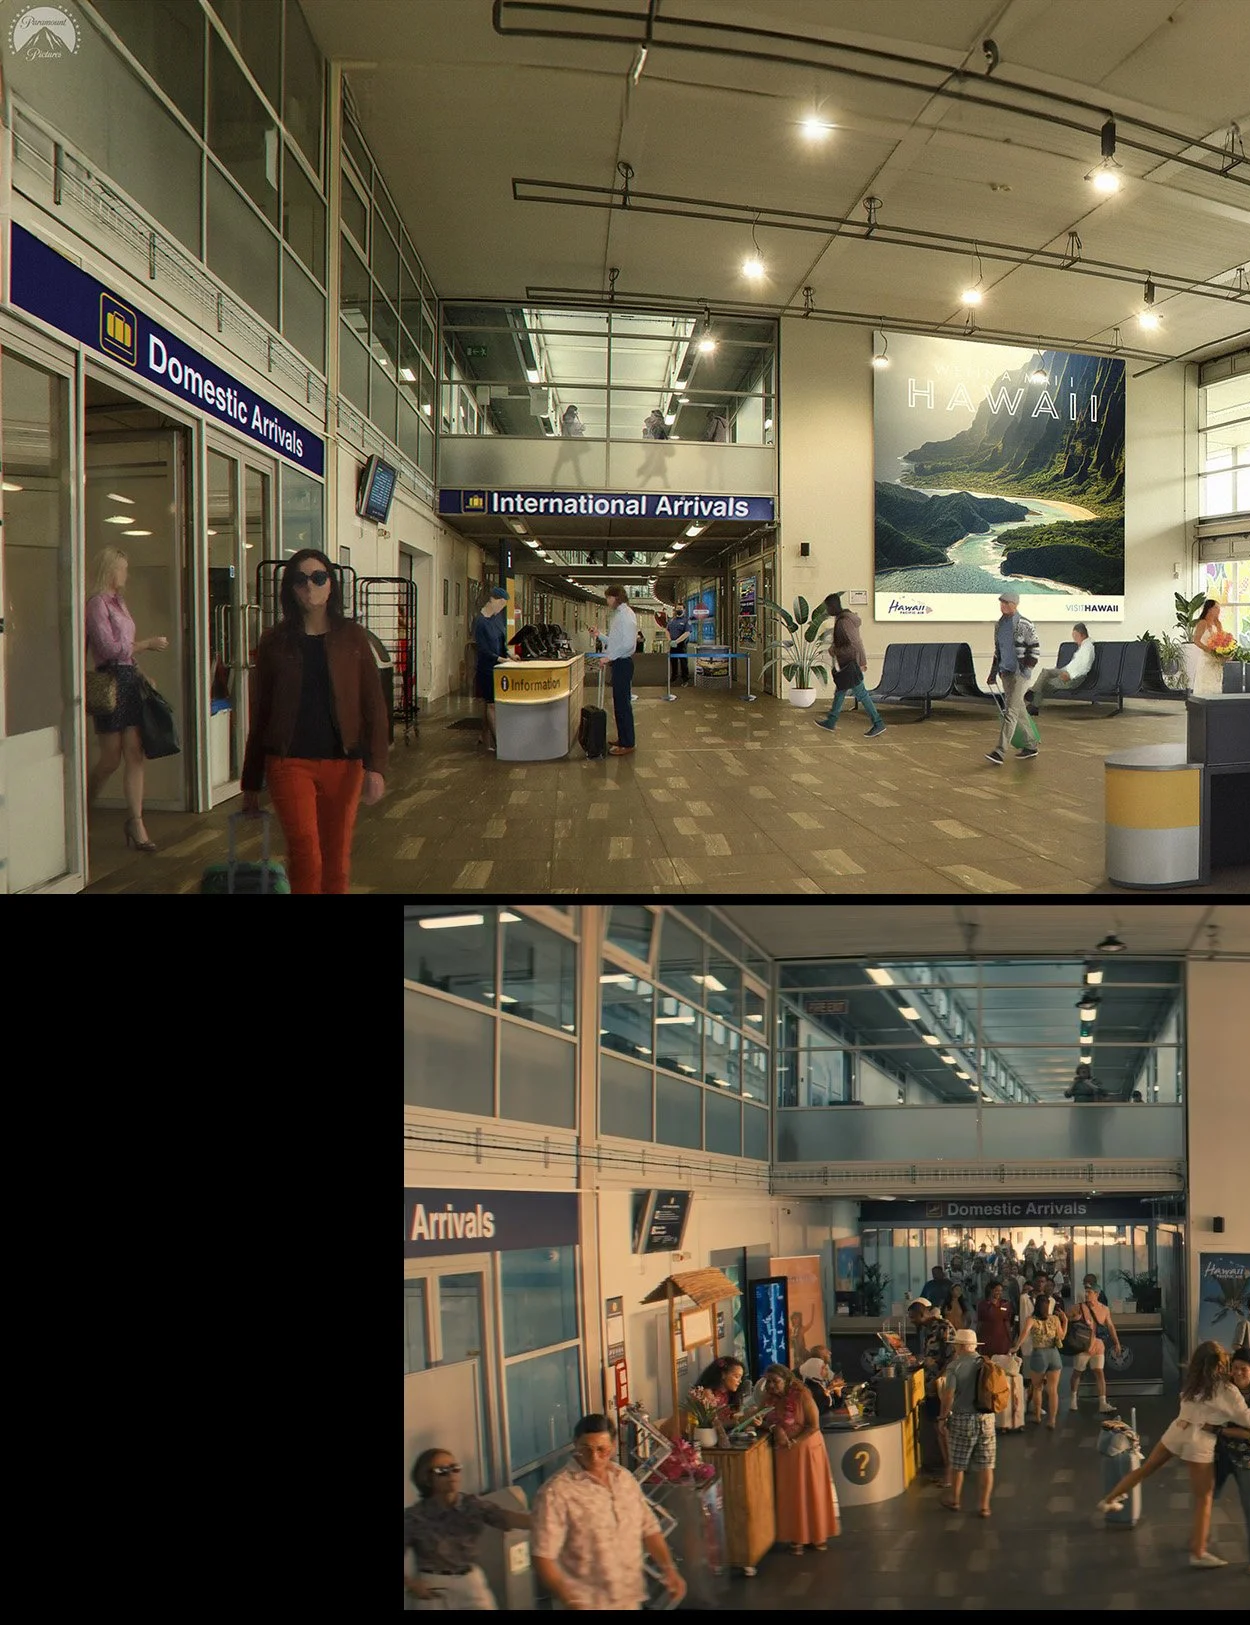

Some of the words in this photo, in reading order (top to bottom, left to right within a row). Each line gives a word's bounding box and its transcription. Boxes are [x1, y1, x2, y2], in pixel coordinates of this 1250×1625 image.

[149, 334, 248, 424] Domestic
[251, 405, 303, 457] Arrivals
[908, 377, 1098, 423] HAWAII
[493, 492, 647, 515] International
[655, 495, 749, 518] Arrivals
[888, 599, 925, 613] Hawaii
[511, 677, 561, 691] Information
[947, 1202, 1022, 1216] Domestic
[1025, 1201, 1087, 1215] Arrivals
[411, 1203, 495, 1240] Arrivals
[1204, 1261, 1244, 1278] Hawaii
